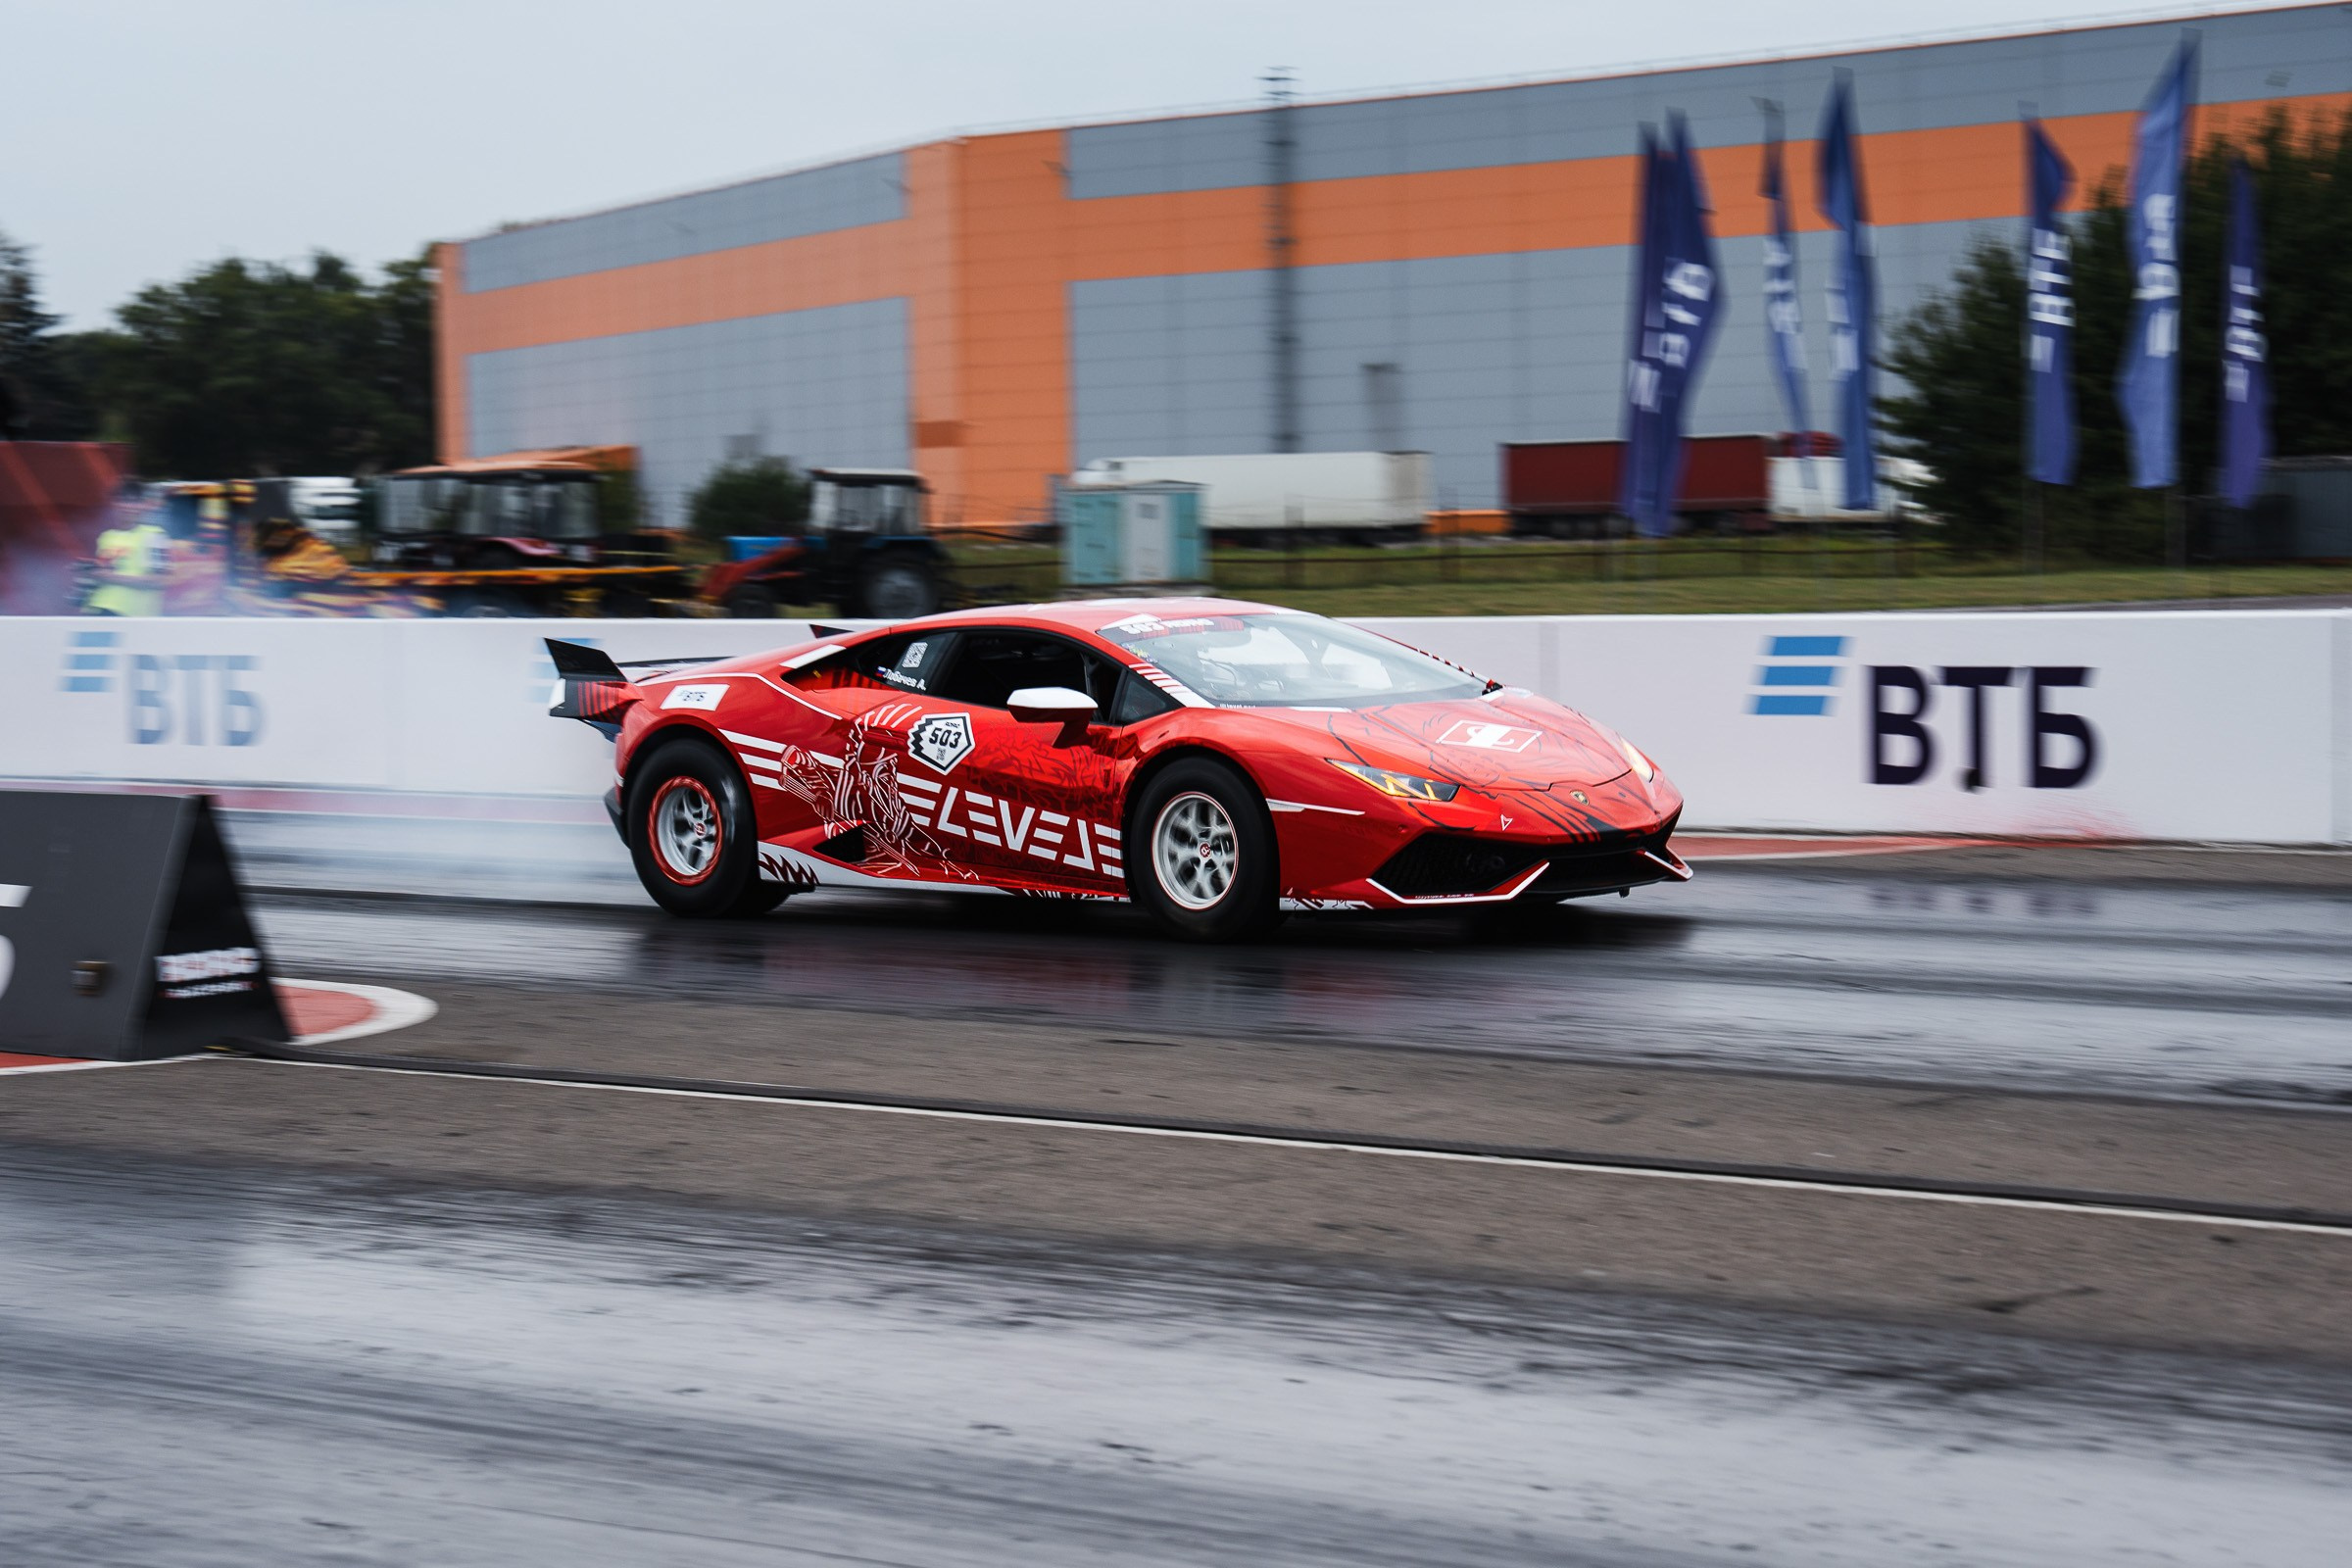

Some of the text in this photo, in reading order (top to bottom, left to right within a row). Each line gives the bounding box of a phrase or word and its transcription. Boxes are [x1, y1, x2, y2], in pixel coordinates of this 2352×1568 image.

[127, 655, 265, 747] ВТБ
[928, 727, 962, 750] 503
[1863, 664, 2102, 790] ВТБ
